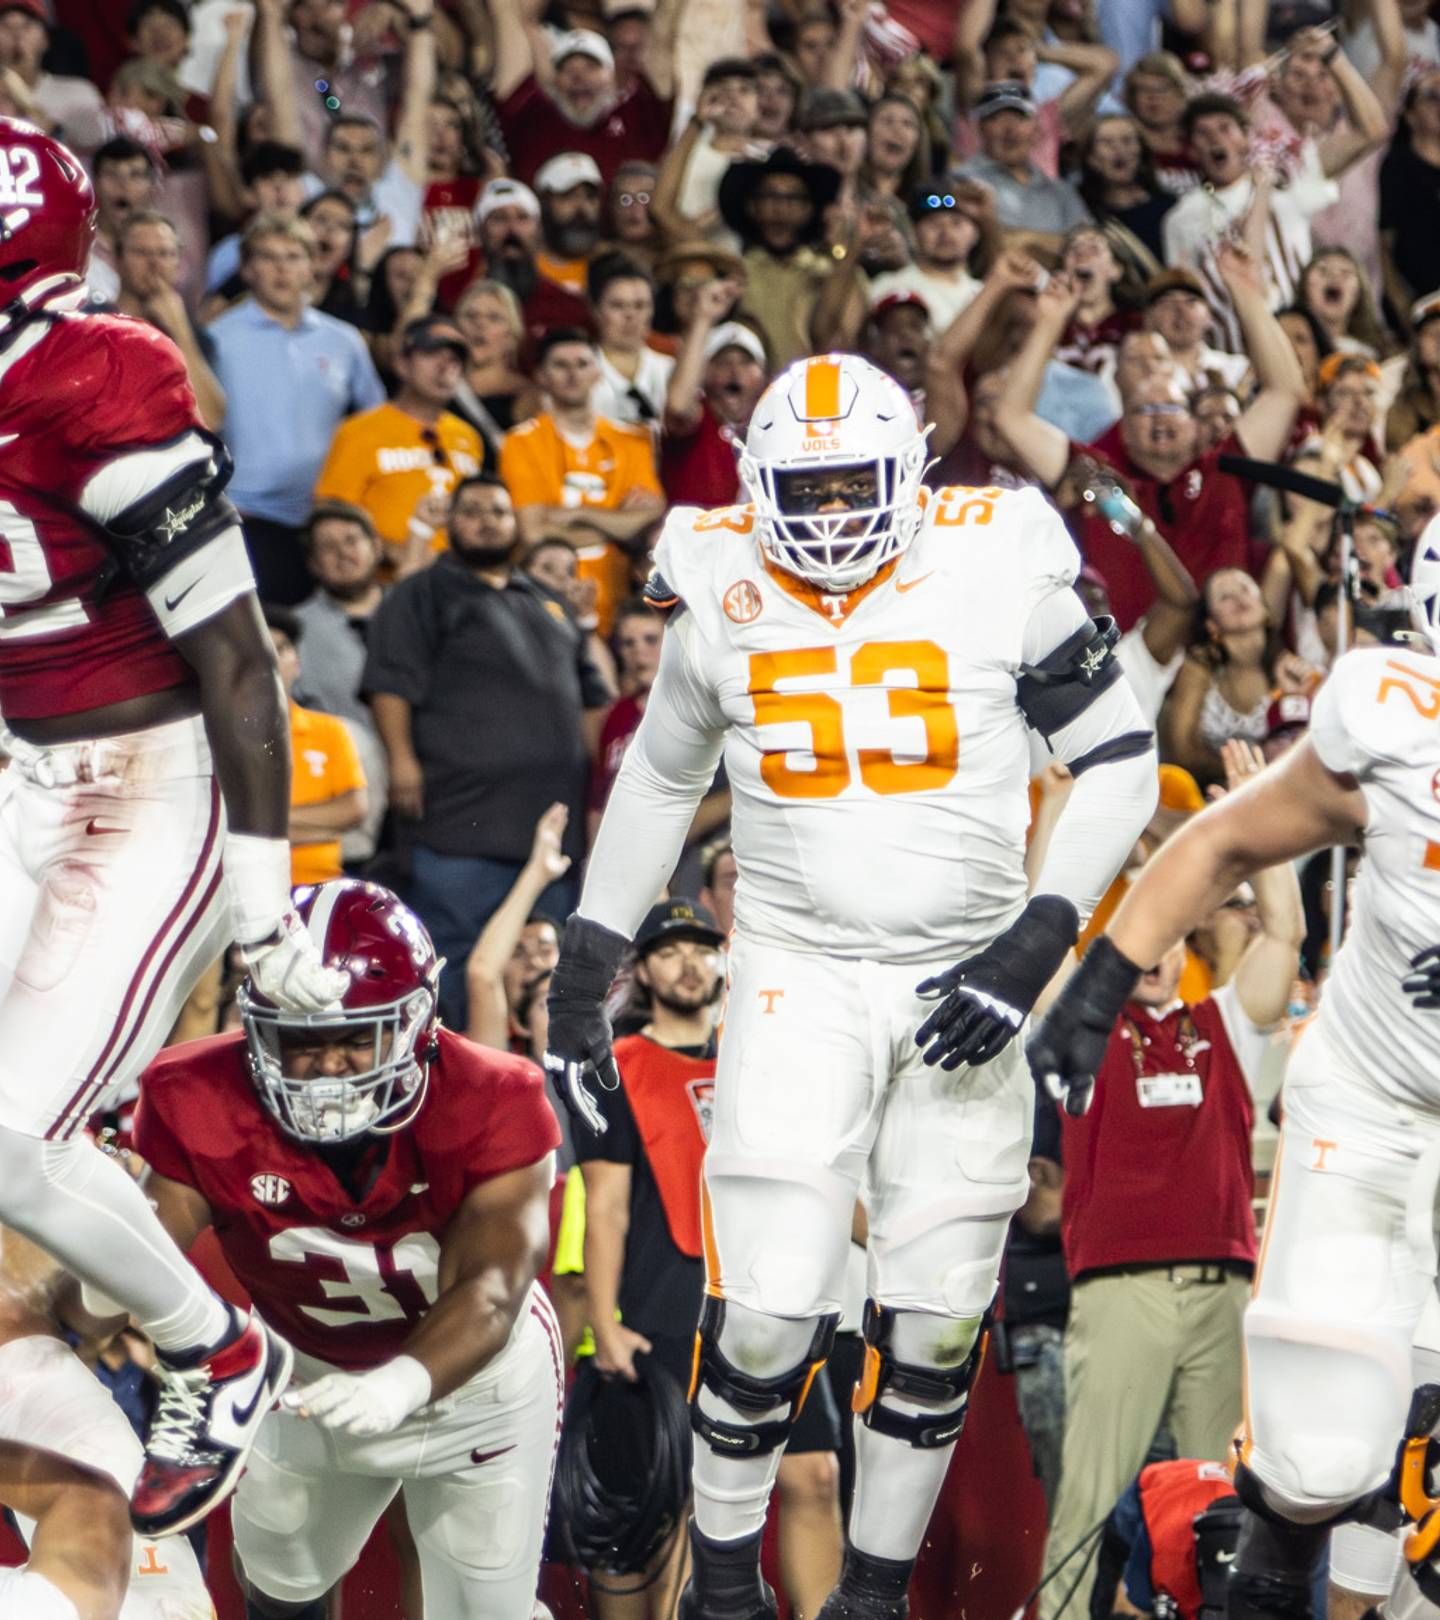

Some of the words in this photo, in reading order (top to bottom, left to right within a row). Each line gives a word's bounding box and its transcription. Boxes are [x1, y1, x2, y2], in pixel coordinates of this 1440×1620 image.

[802, 438, 840, 452] VOLS
[724, 581, 761, 622] SEC
[822, 593, 848, 620] T
[747, 640, 960, 798] 53
[758, 989, 785, 1015] T
[1312, 1139, 1337, 1170] T
[250, 1174, 291, 1204] SEC
[138, 1546, 168, 1575] T
